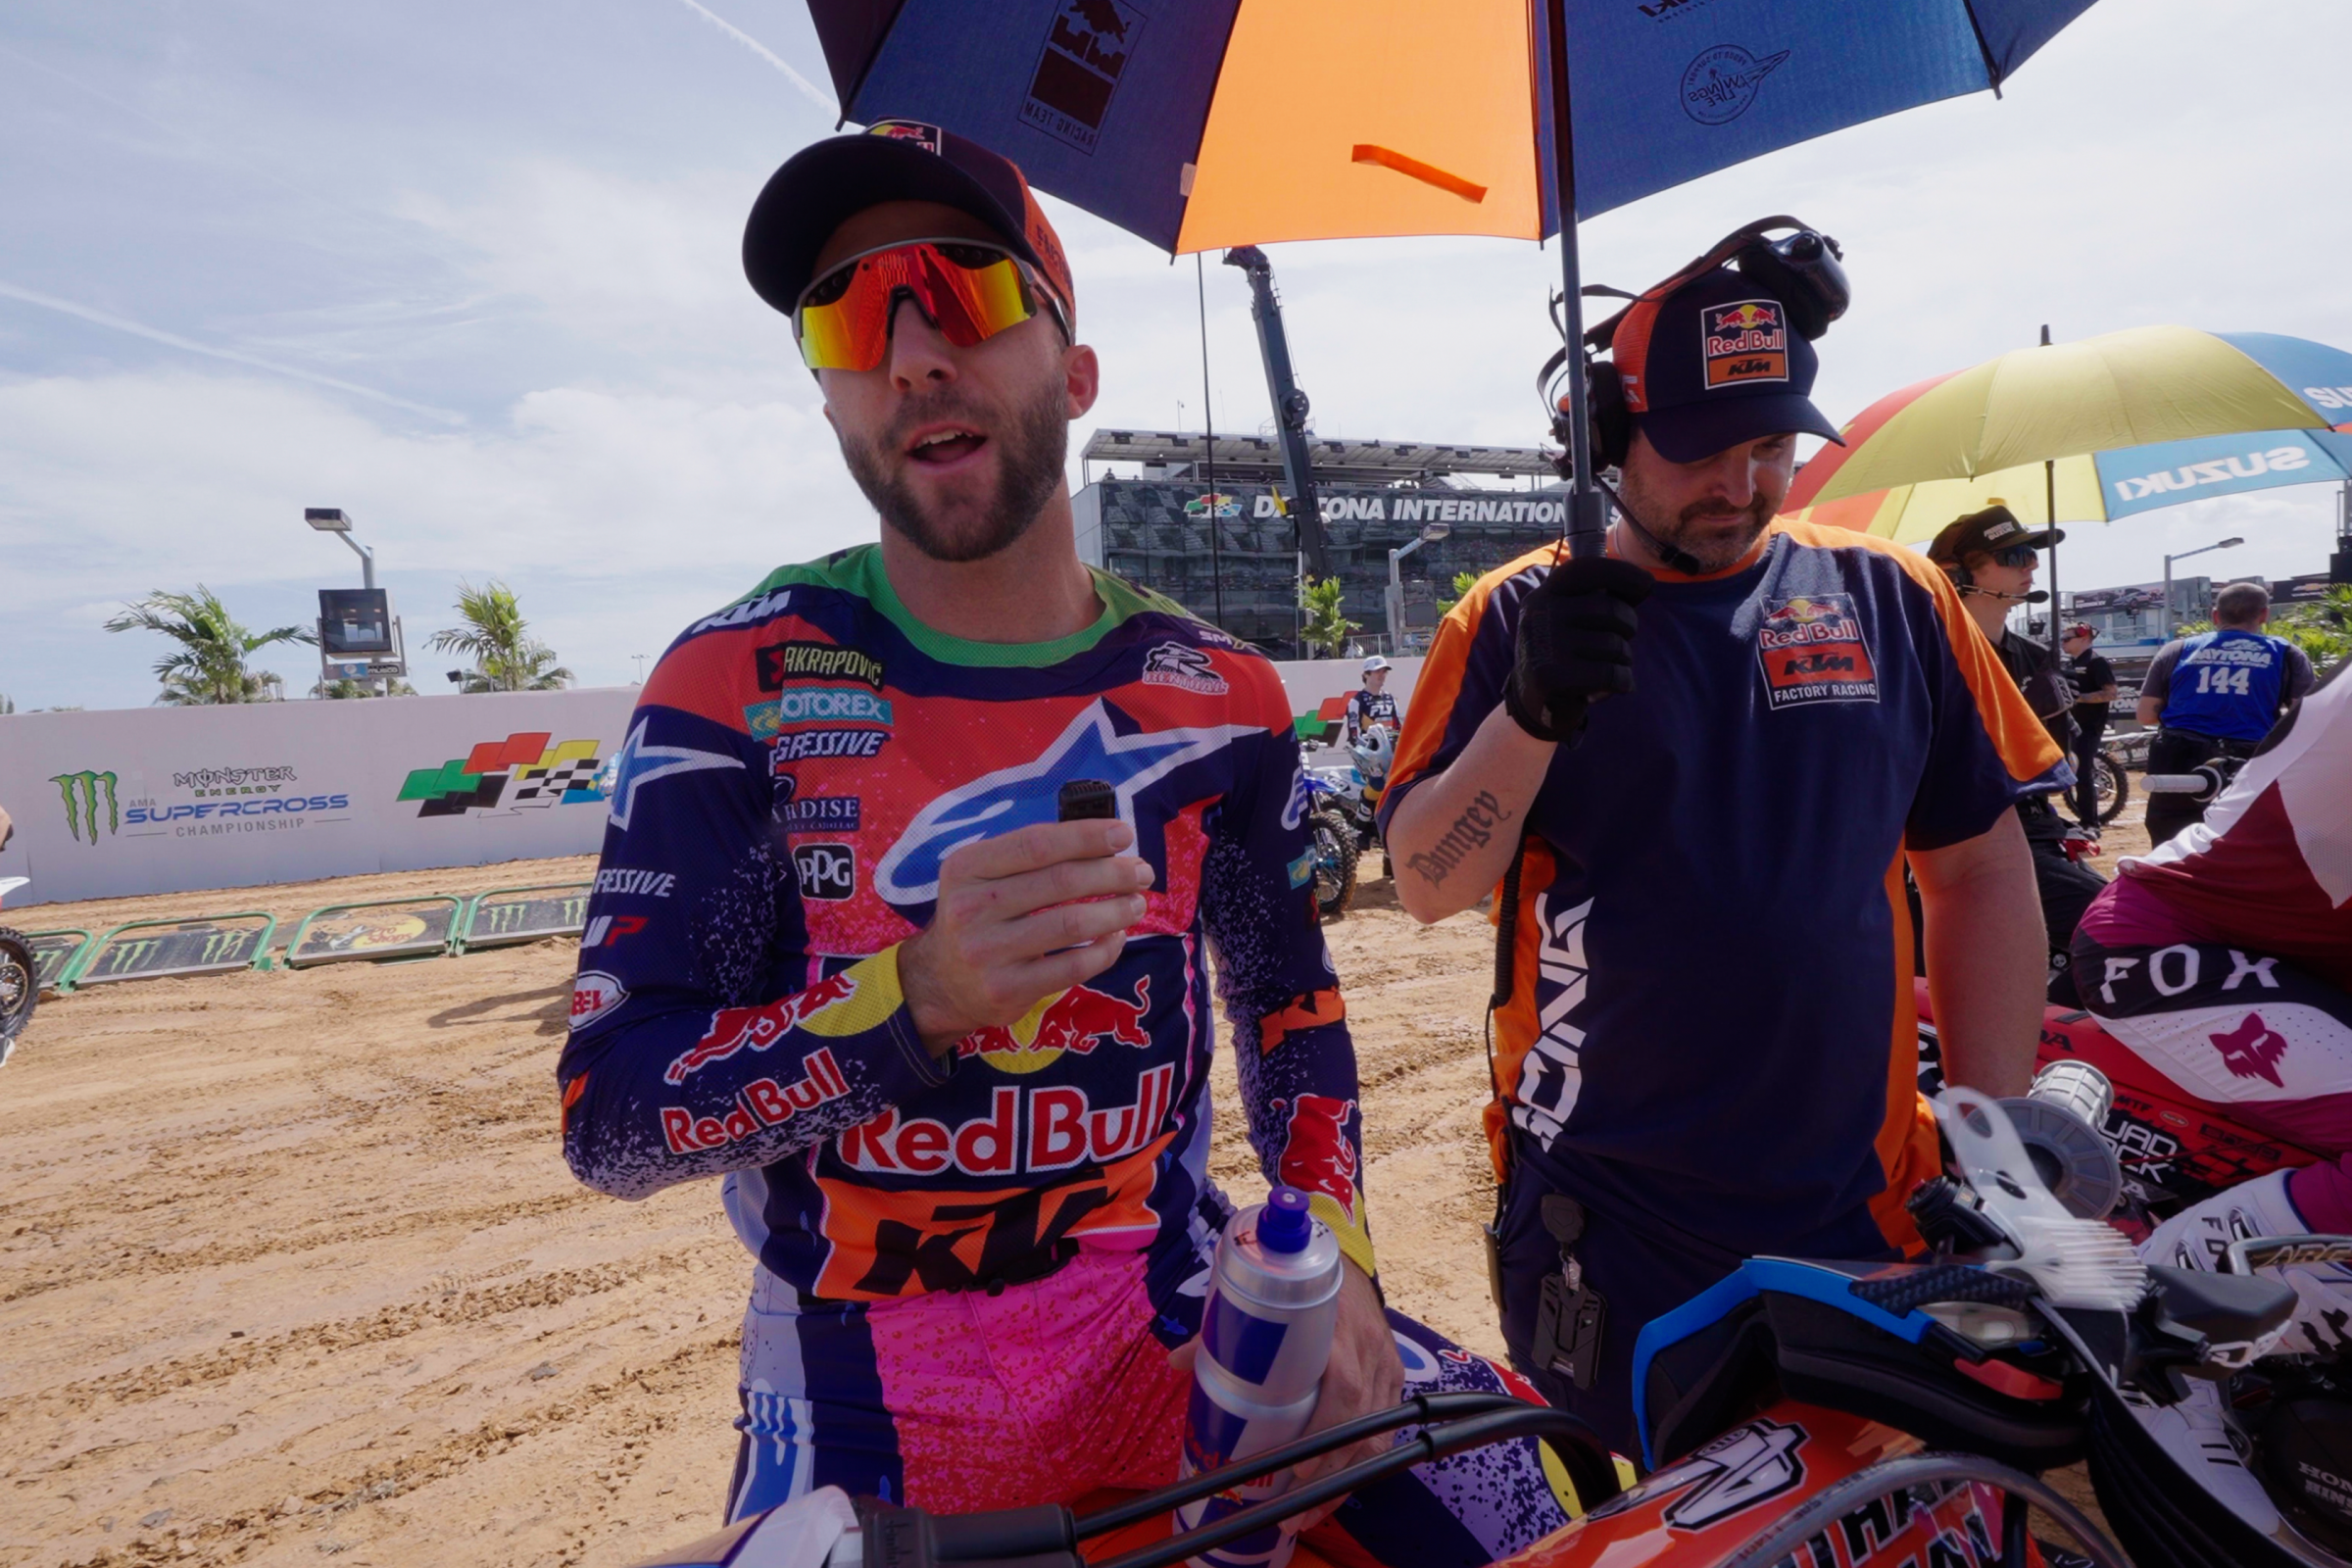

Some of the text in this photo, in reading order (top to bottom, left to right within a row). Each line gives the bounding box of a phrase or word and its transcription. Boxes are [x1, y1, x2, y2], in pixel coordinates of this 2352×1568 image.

[1707, 328, 1784, 357] Red Bull
[1727, 358, 1771, 376] KTM
[1393, 498, 1565, 523] INTERNATION
[1759, 619, 1859, 649] Red Bull
[1784, 652, 1854, 676] KTM
[1774, 683, 1876, 703] FACTORY RACING
[2196, 666, 2251, 695] 144
[781, 692, 885, 720] OTOREX
[1369, 703, 1394, 716] FLY
[172, 766, 298, 788] MONSTER
[195, 784, 282, 797] ENERGY
[123, 794, 350, 824] SUPERCROSS
[128, 799, 157, 808] AMA
[175, 817, 306, 837] CHAMPIONSHIP
[1404, 790, 1512, 891] Dungey
[799, 850, 851, 894] PPG
[2099, 943, 2280, 1004] FOX
[660, 1046, 852, 1155] Red Bull
[837, 1061, 1176, 1177] Red Bull
[2099, 1114, 2178, 1162] UAD
[2297, 1460, 2352, 1494] HON
